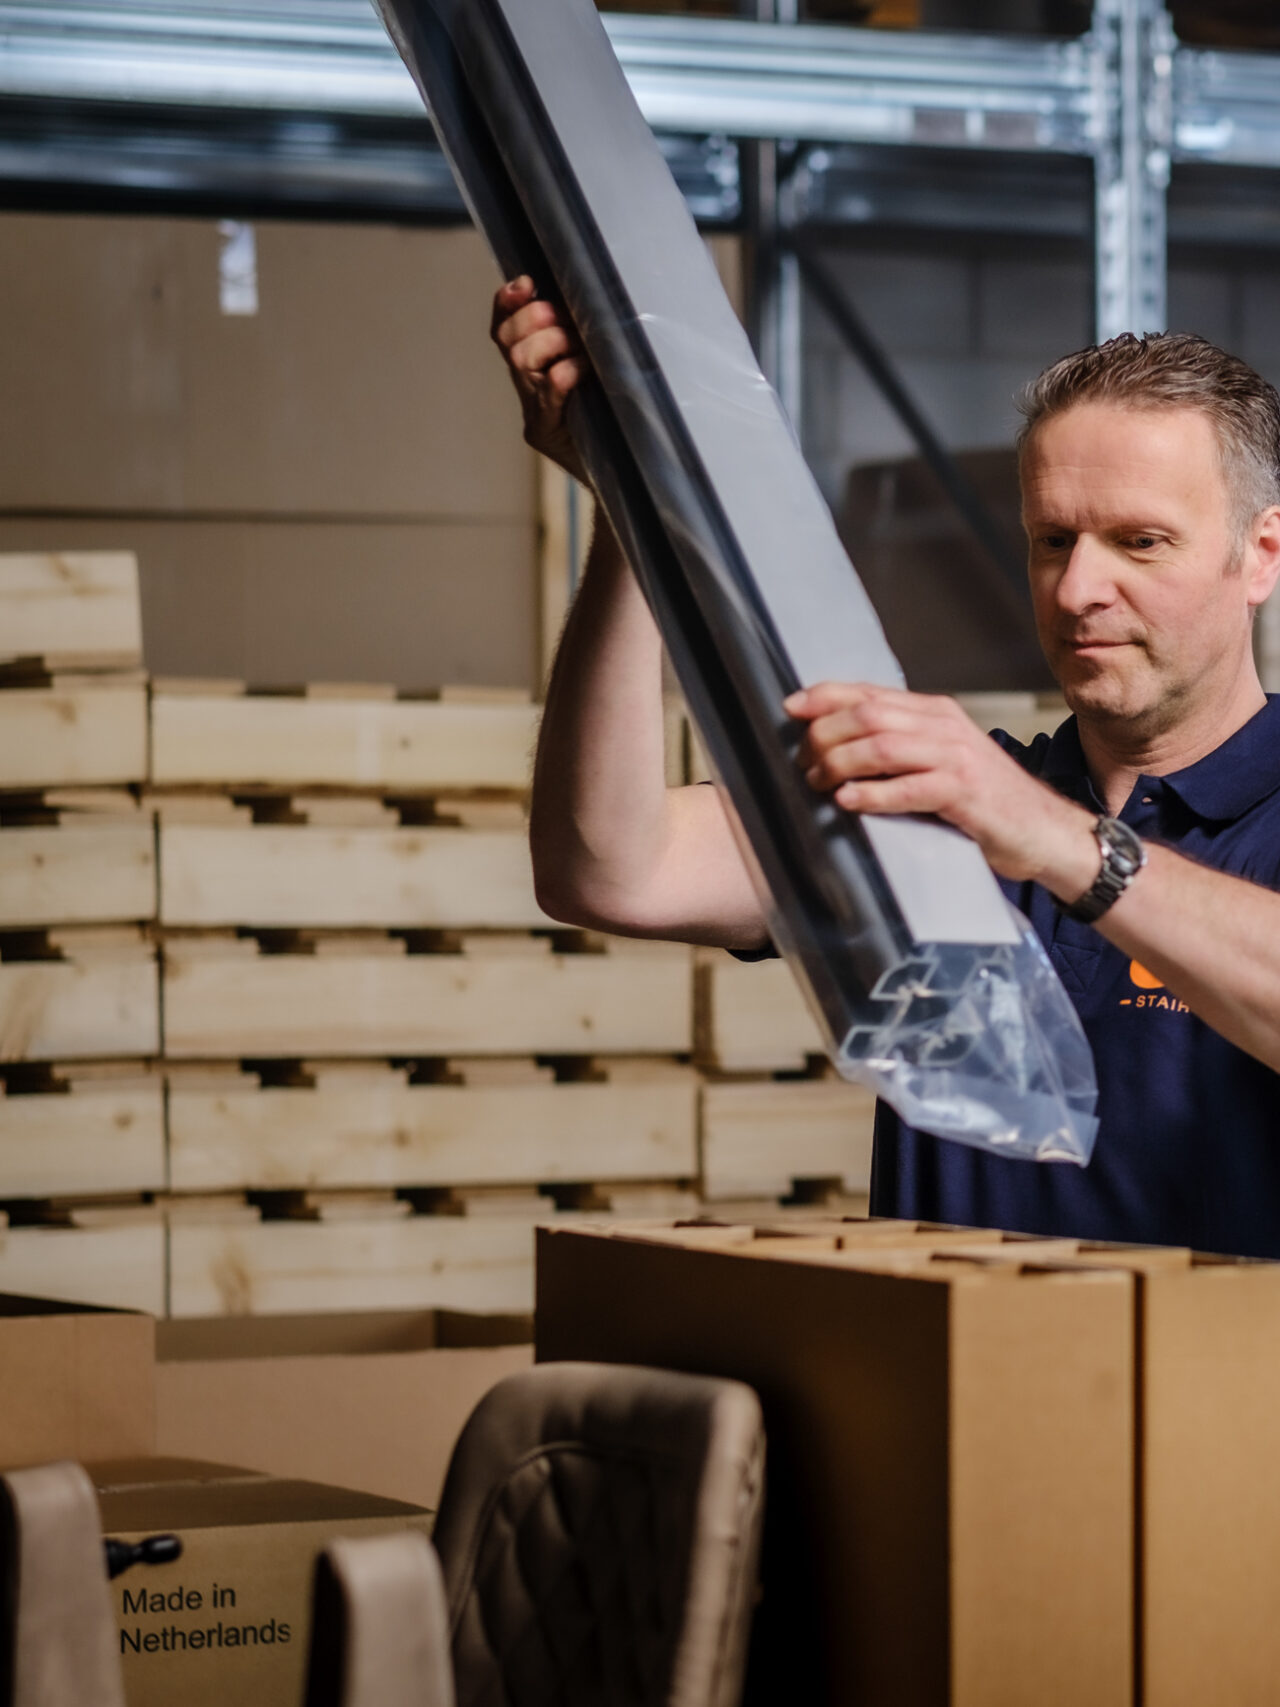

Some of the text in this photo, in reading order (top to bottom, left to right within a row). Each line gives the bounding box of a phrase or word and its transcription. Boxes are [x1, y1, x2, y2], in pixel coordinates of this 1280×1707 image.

[122, 1584, 236, 1614] Made in
[120, 1618, 292, 1654] Netherlands
